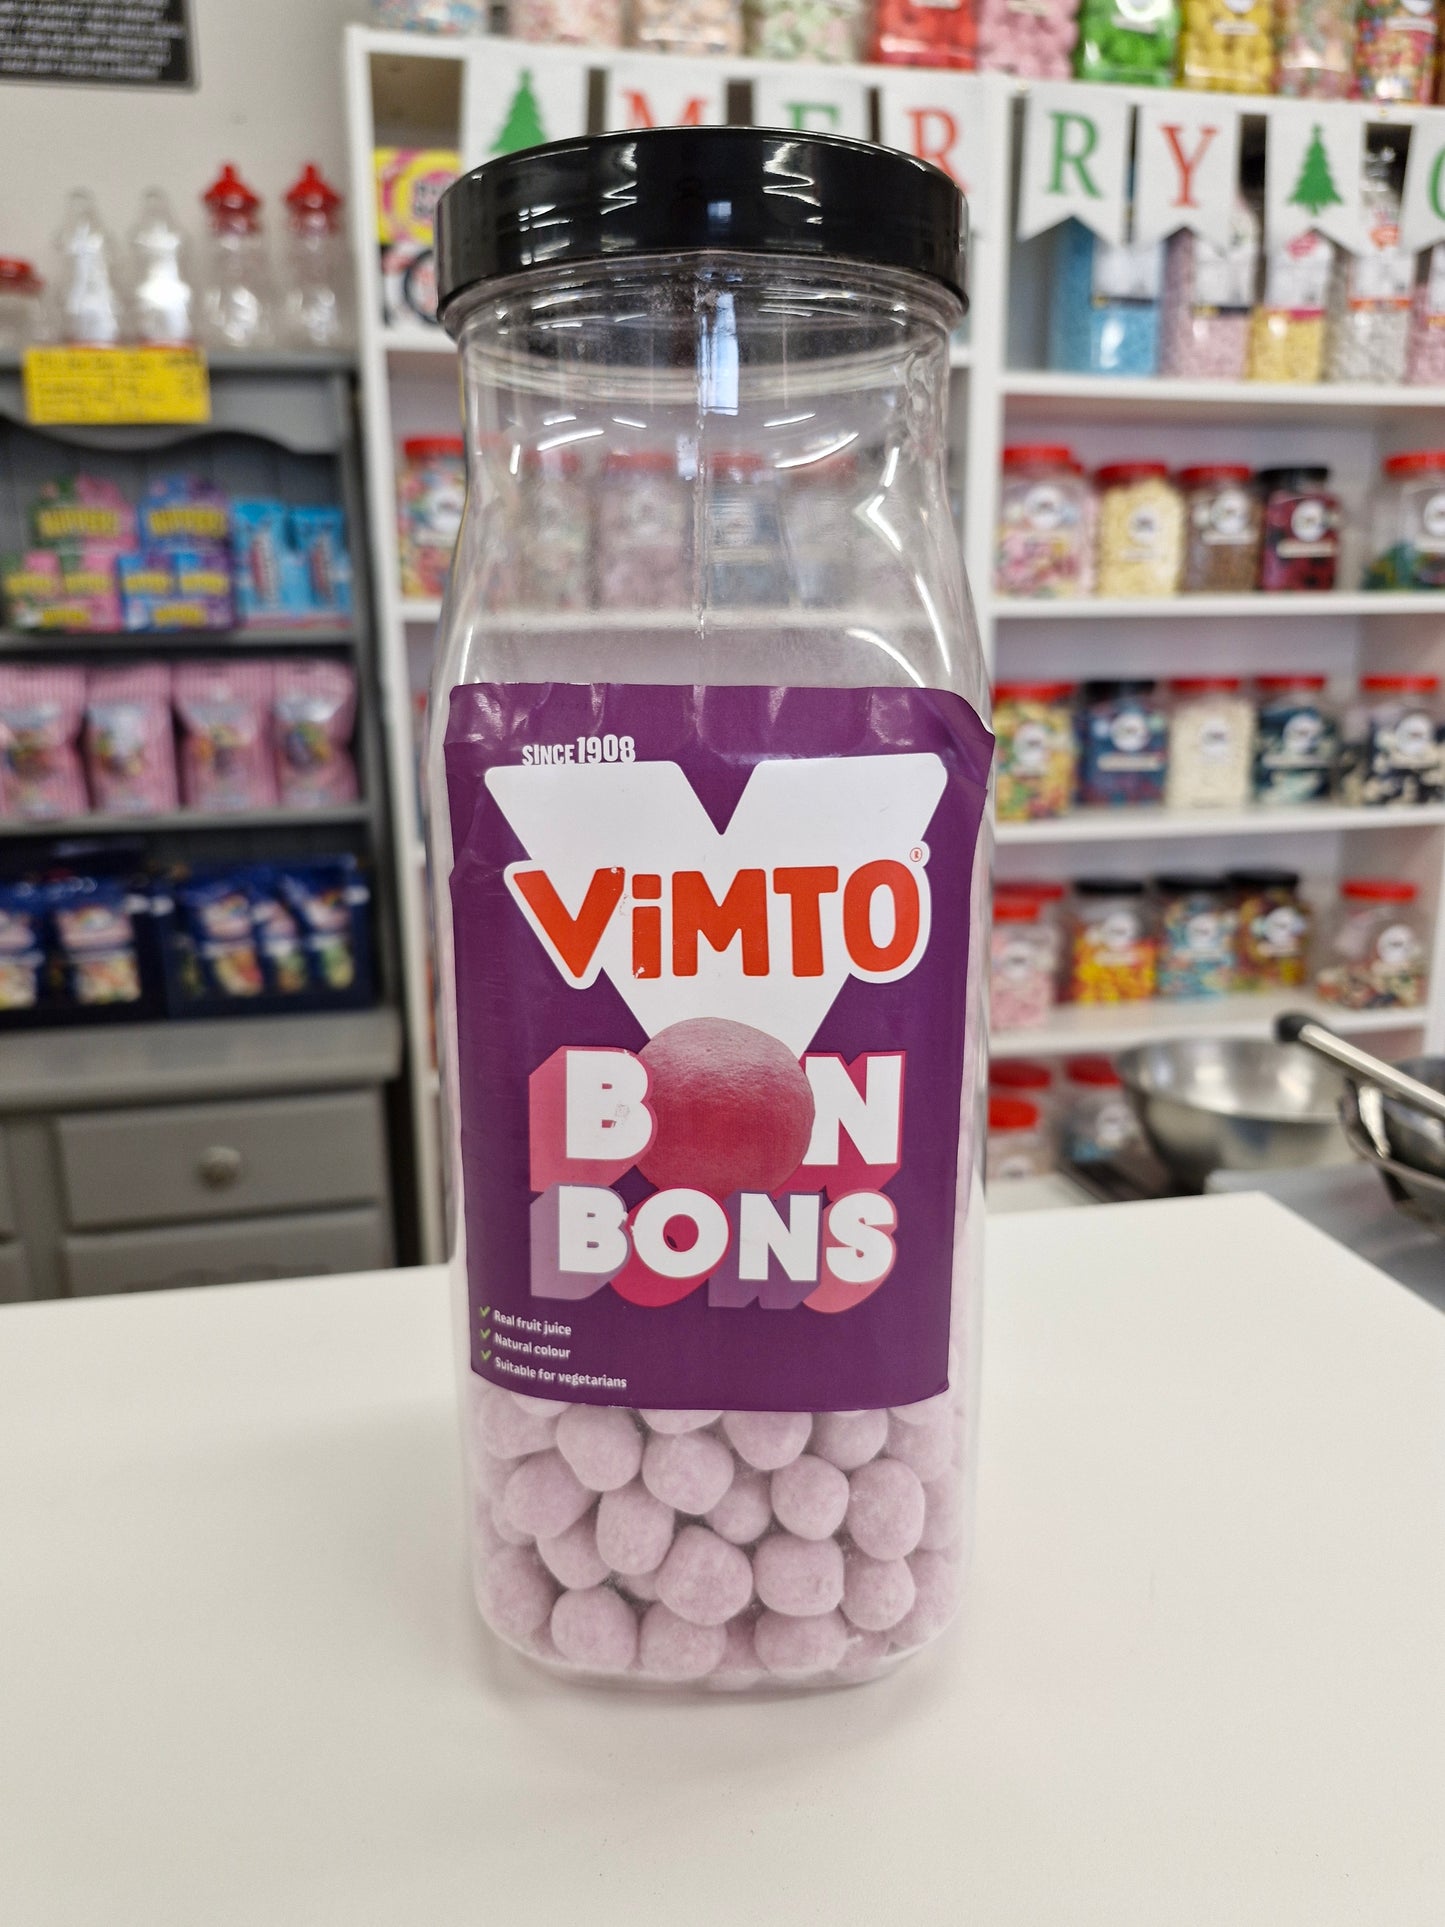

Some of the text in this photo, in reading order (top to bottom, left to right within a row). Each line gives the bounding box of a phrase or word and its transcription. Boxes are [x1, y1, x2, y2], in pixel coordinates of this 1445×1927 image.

[521, 733, 636, 766] SINCE 1908
[550, 1183, 898, 1288] BONS
[494, 1309, 572, 1336] Real fruit juice
[494, 1332, 571, 1359] Natural colour
[495, 1356, 628, 1388] Suitable for vegetarians
